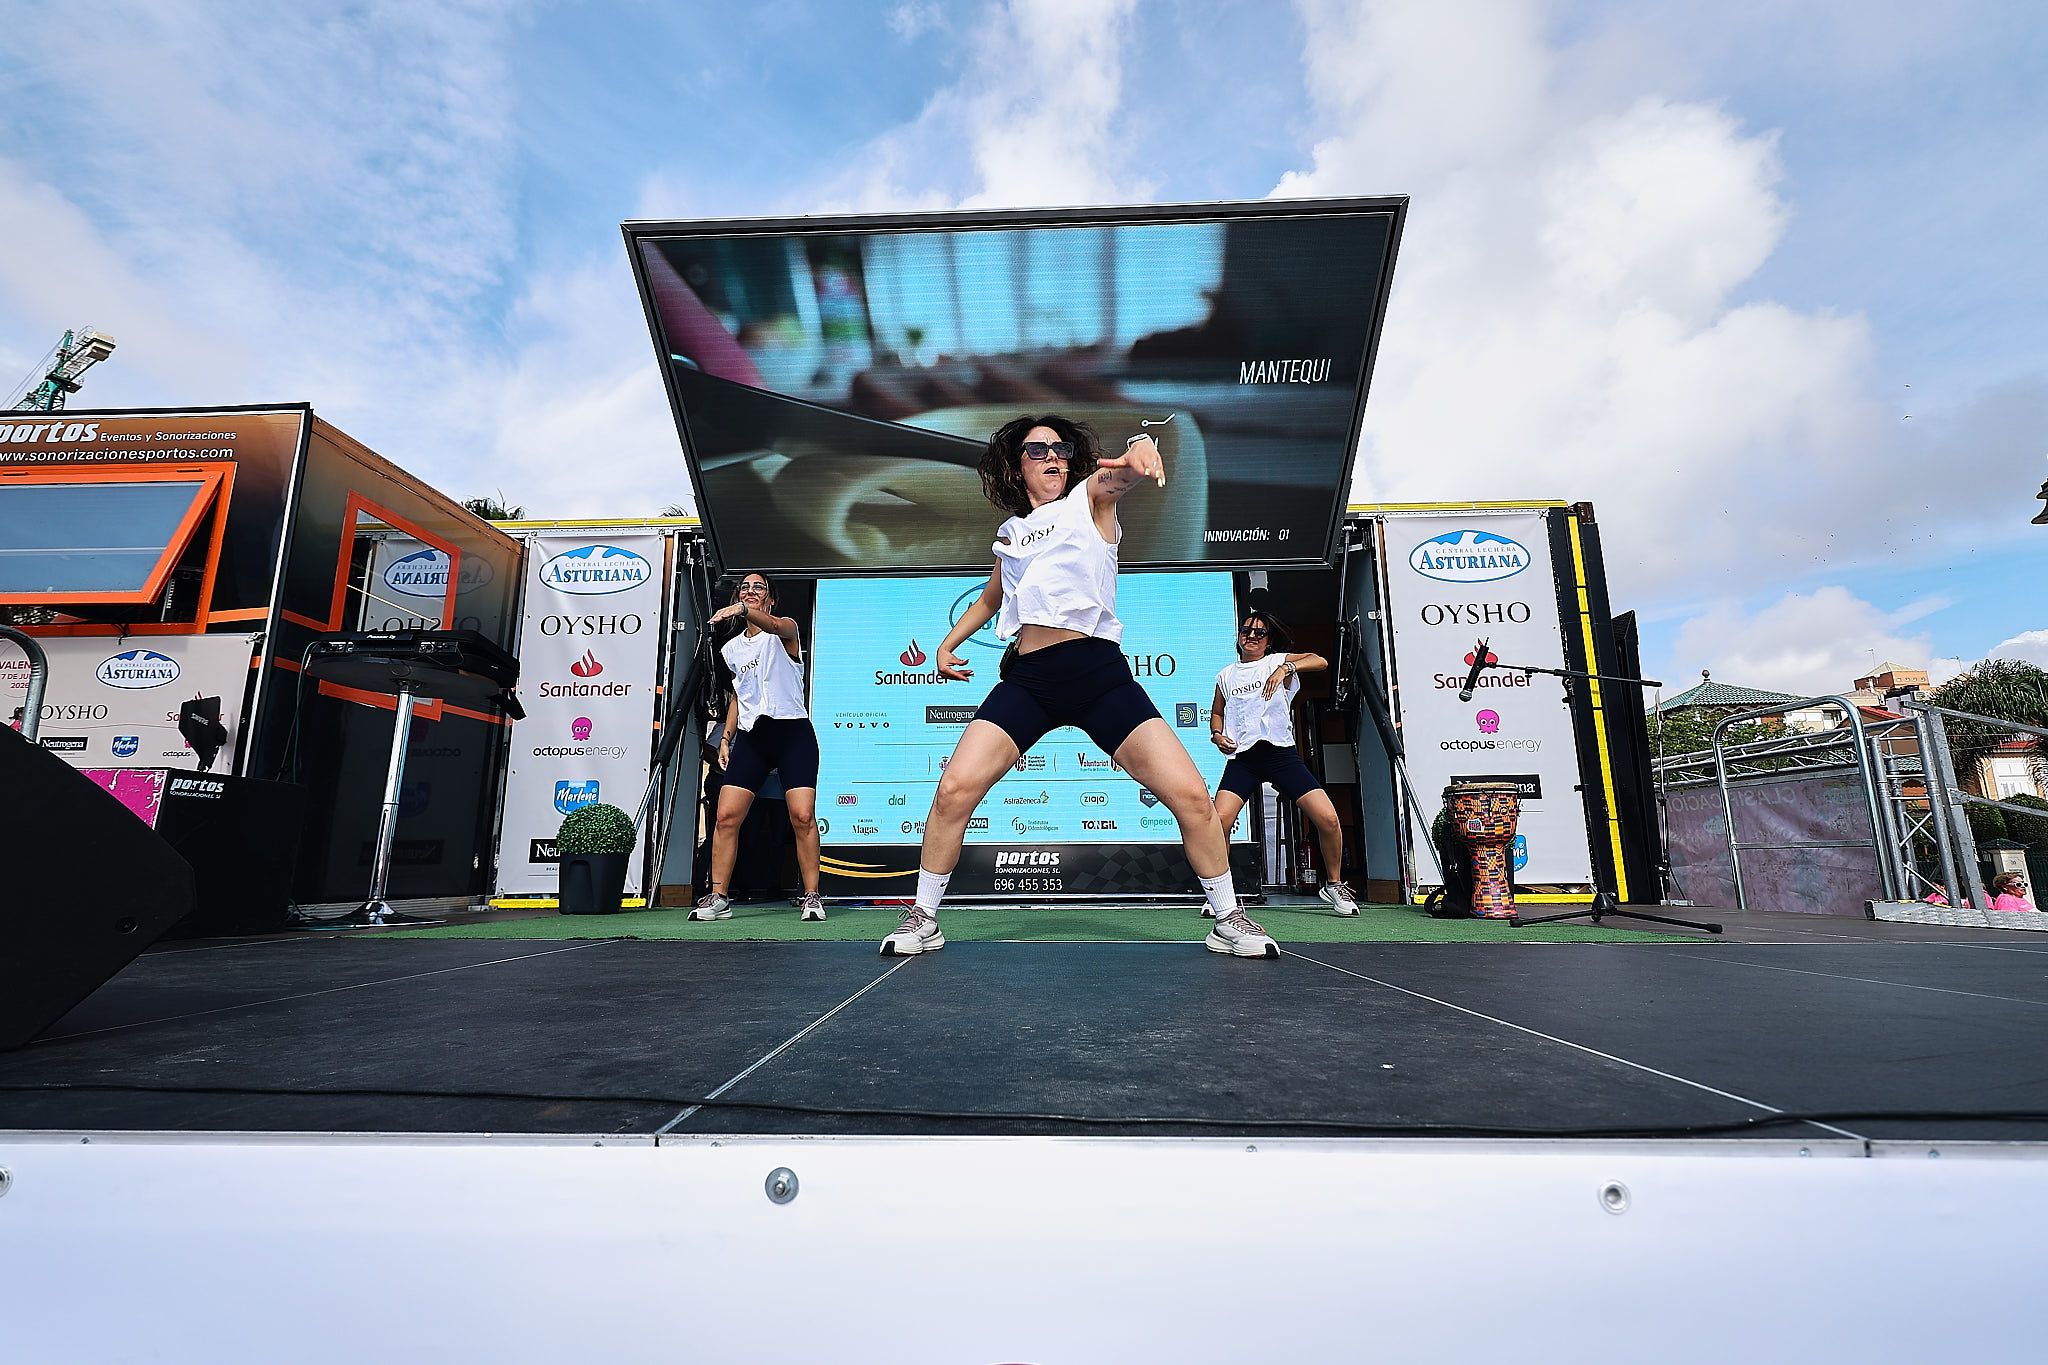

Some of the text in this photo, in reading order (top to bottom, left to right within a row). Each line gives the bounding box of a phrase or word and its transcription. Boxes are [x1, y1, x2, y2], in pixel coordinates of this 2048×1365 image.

[1239, 358, 1332, 384] MANTEQUI
[100, 432, 142, 442] Eventos
[145, 433, 152, 442] y
[154, 430, 237, 441] Sonorizaciones
[1021, 524, 1055, 546] OYSH
[1203, 527, 1290, 543] INNOVACIÓN: 01
[1418, 550, 1523, 570] ASTURIANA
[546, 563, 643, 583] ASTURIANA
[1420, 602, 1531, 626] OYSHO
[540, 613, 642, 636] OYSHO
[0, 661, 31, 670] VALEN
[101, 664, 174, 680] ASTURIANA
[539, 681, 632, 698] Santander
[1231, 680, 1263, 697] OYSHO
[40, 704, 108, 720] OYSHO
[929, 709, 975, 722] Neutrogena
[41, 739, 84, 750] Neutrogena
[170, 778, 225, 793] portos
[556, 787, 598, 808] Marlene
[888, 794, 906, 806] dial
[1003, 797, 1041, 806] AstraZeneca
[1084, 796, 1105, 805] ziaja
[852, 825, 879, 836] Magas
[995, 851, 1060, 868] portos
[994, 878, 1063, 891] 696 455 353
